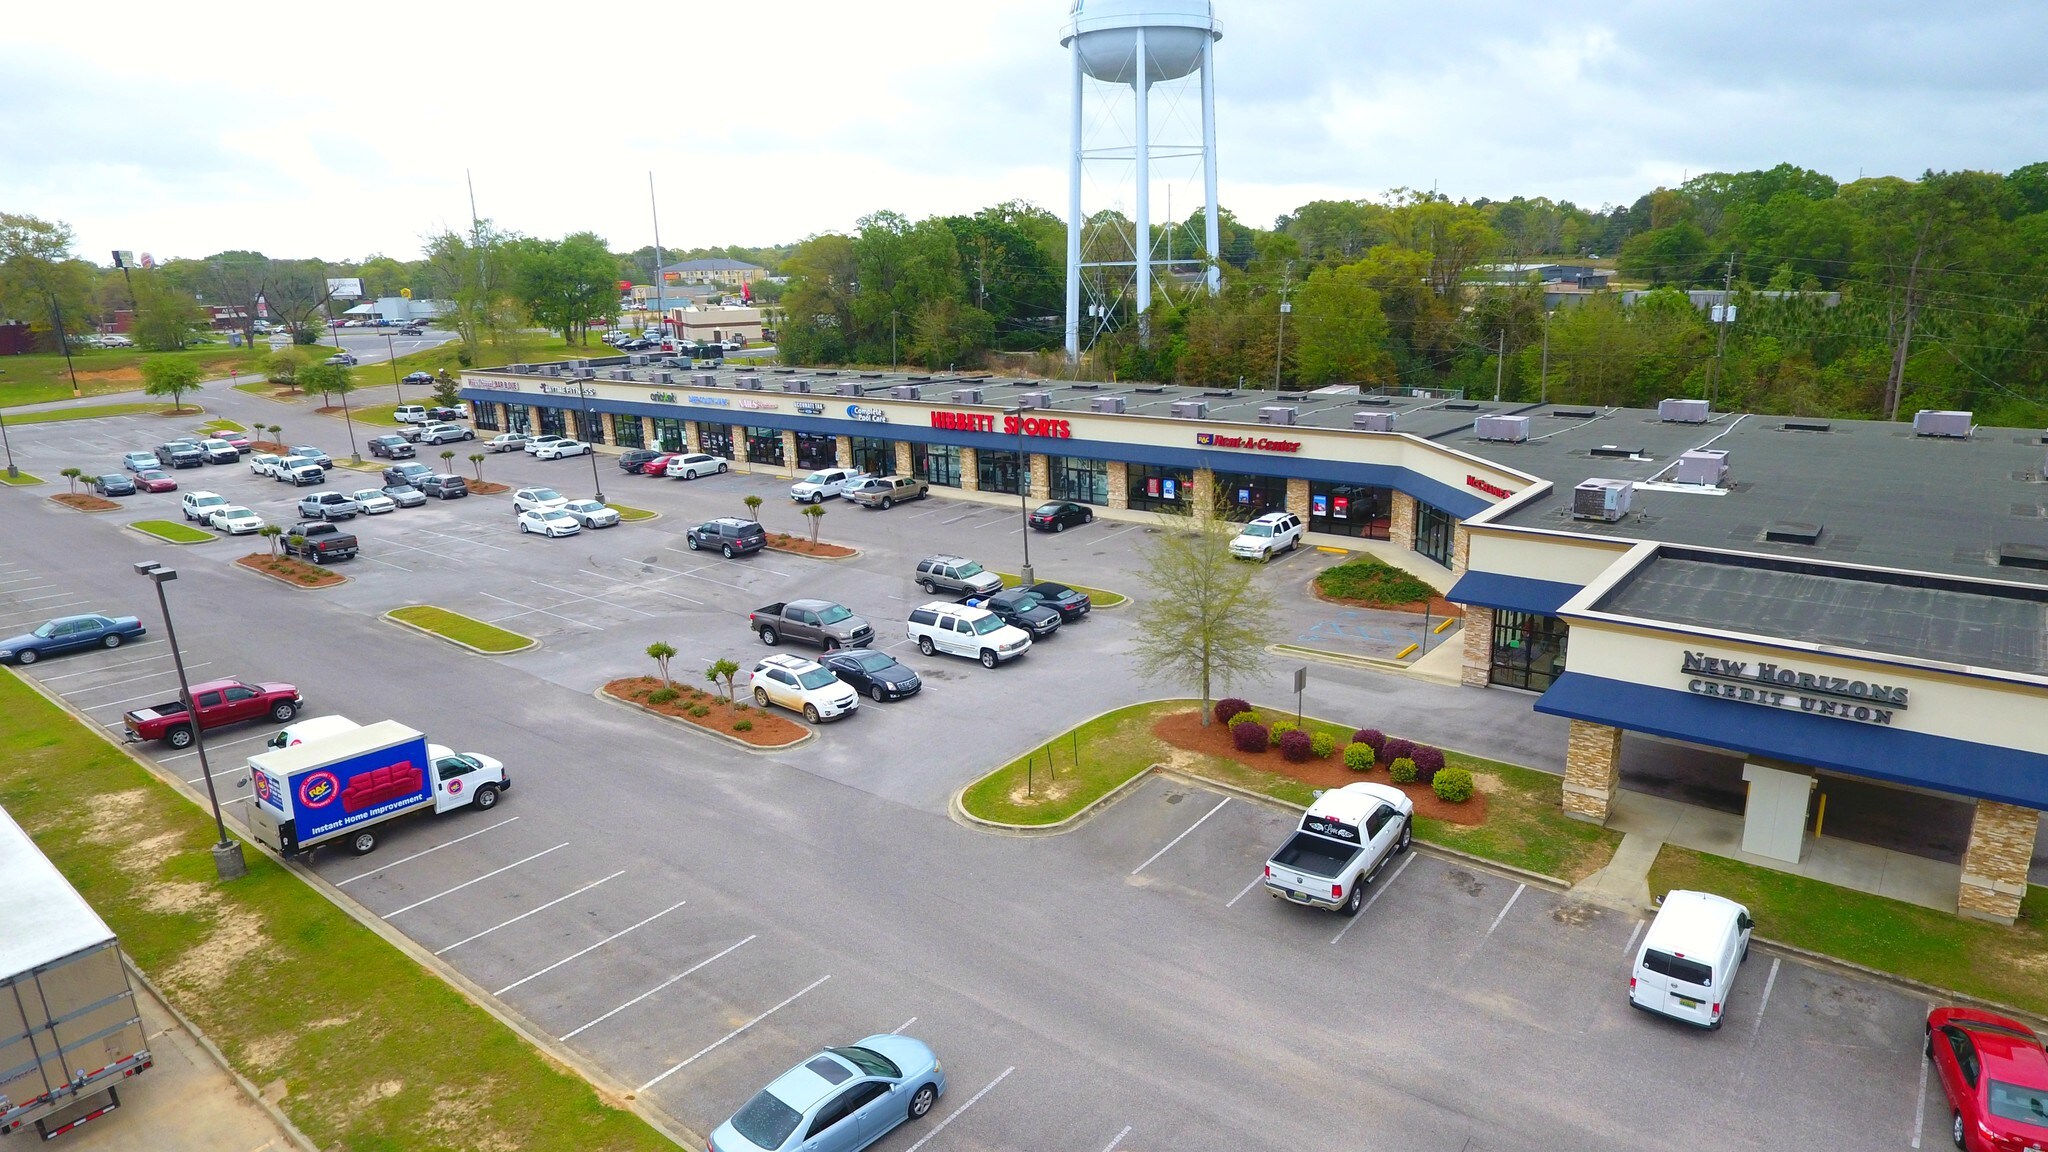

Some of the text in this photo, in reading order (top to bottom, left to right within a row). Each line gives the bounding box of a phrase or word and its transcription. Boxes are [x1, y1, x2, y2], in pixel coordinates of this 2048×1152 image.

[739, 399, 758, 409] NAILS
[854, 407, 882, 417] Complete
[858, 414, 886, 423] Pool Care
[931, 411, 1071, 439] HIBBETT SPORTS
[1682, 650, 1909, 705] NEW HORIZONS
[1688, 679, 1893, 725] CREDIT UNION
[308, 781, 330, 798] RAC
[312, 793, 423, 835] Instant Home Improvement
